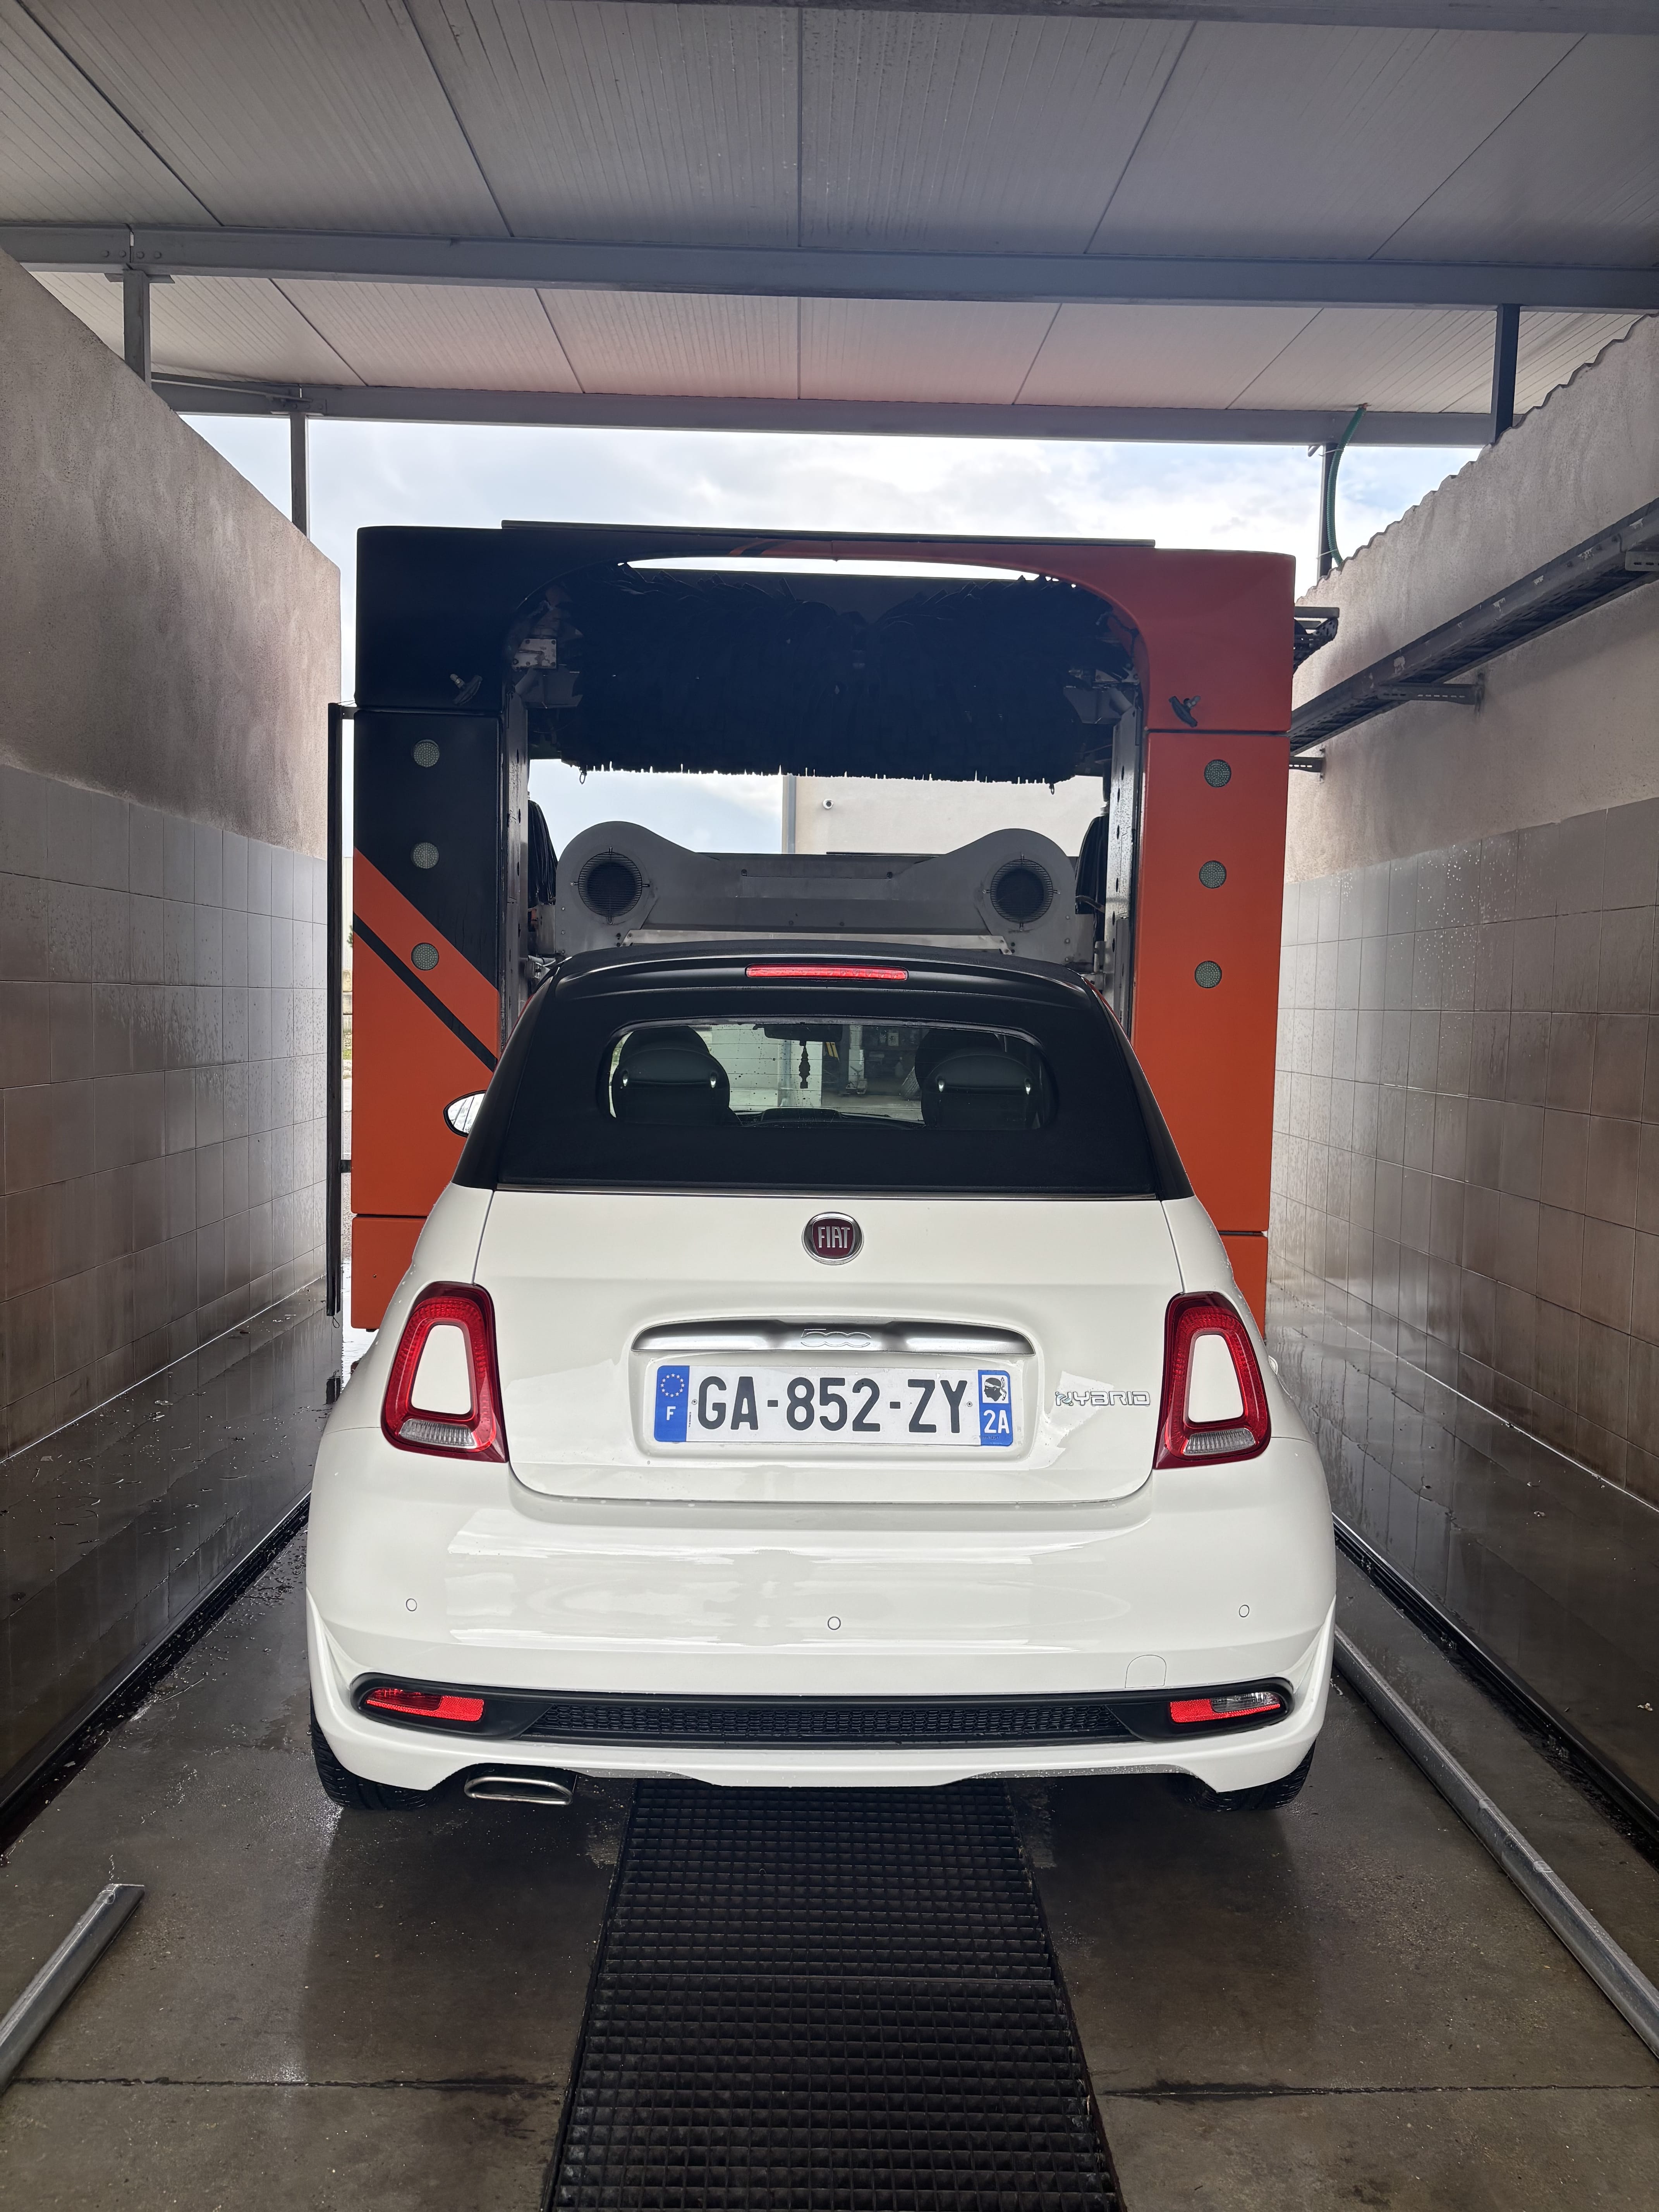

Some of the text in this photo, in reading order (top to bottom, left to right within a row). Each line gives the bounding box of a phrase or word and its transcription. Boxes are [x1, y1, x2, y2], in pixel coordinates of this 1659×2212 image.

[818, 1226, 850, 1248] FIAT
[698, 1376, 967, 1433] GA-852-ZY
[1055, 1391, 1151, 1406] HYBRID
[666, 1406, 676, 1420] F
[983, 1410, 1010, 1434] 2A
